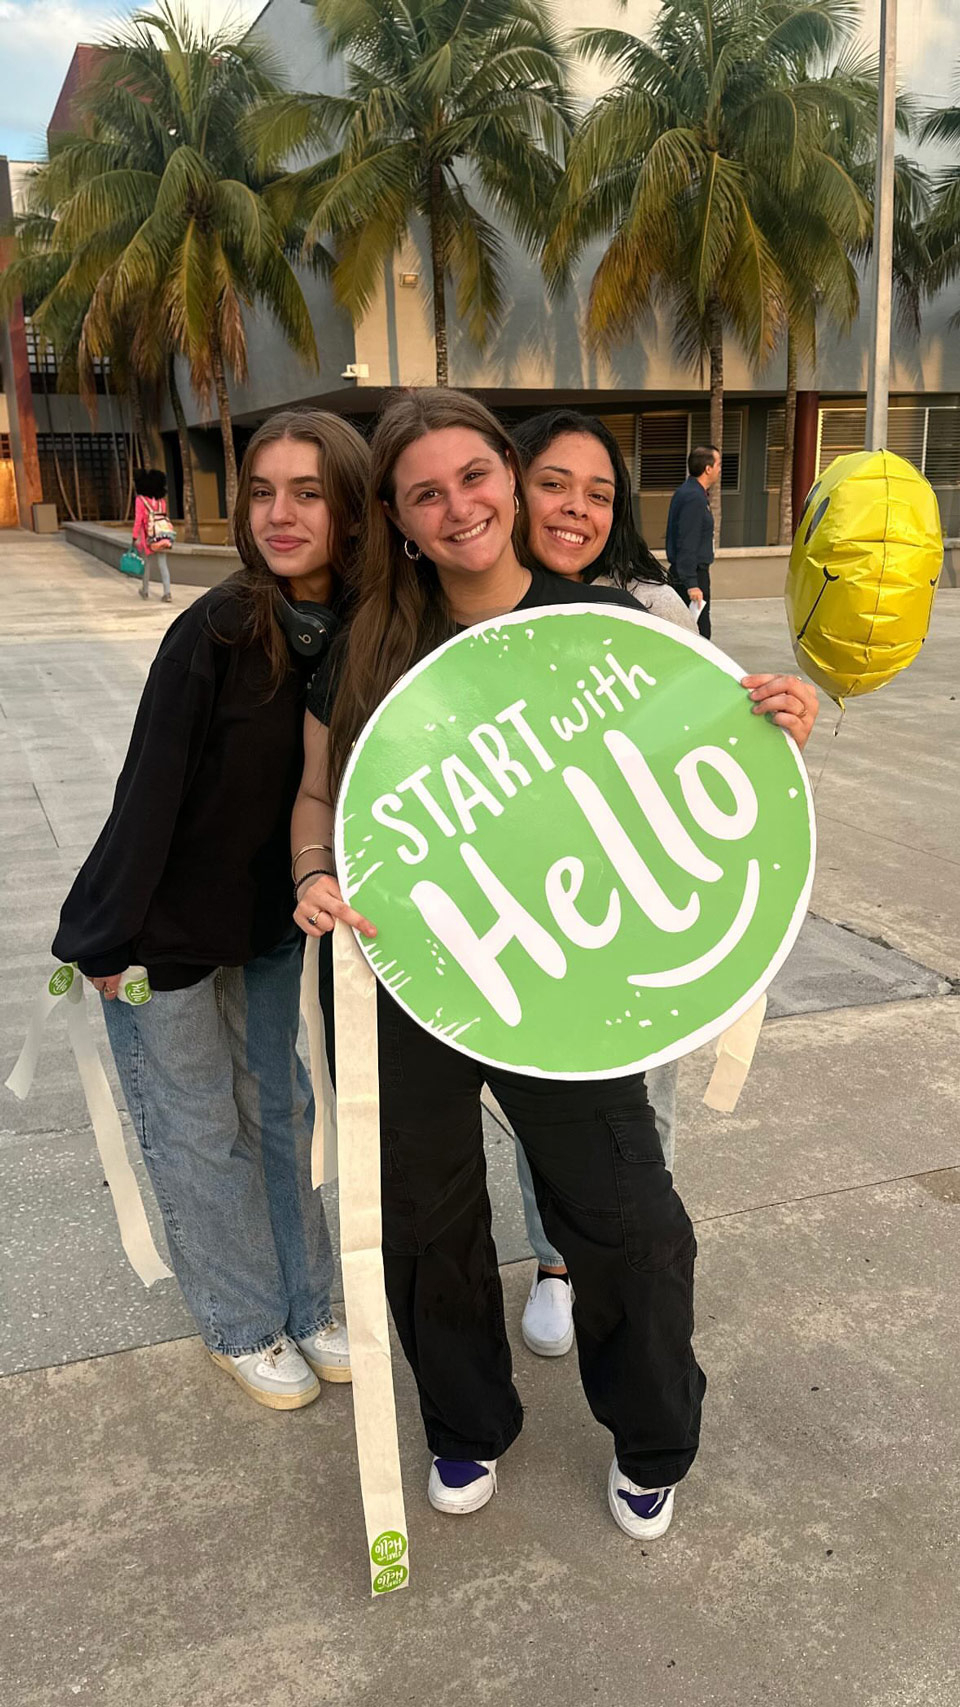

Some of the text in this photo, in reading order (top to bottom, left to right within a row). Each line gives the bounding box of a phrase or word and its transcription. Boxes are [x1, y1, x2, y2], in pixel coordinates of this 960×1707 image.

[371, 652, 657, 865] START with
[409, 729, 759, 1027] Hello
[51, 972, 68, 992] Hello
[130, 982, 145, 1002] Hello
[375, 1537, 403, 1557] Hello
[377, 1568, 404, 1586] Hello
